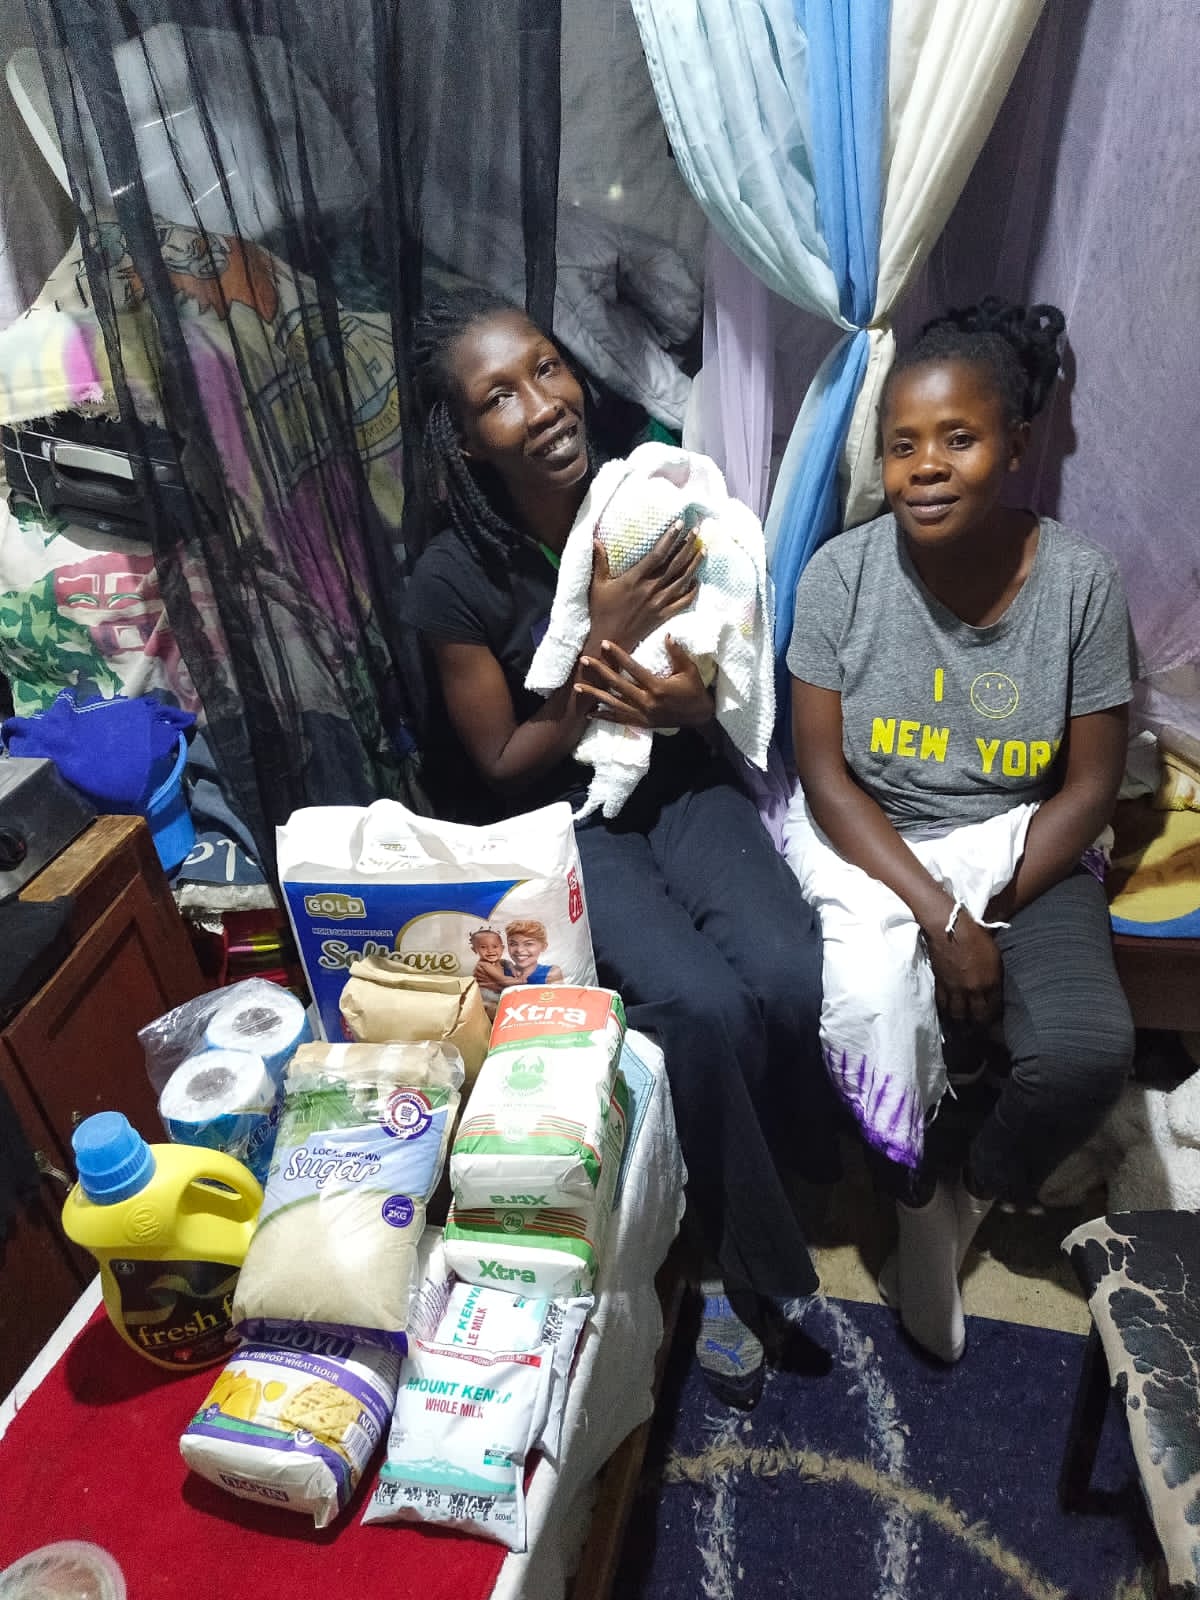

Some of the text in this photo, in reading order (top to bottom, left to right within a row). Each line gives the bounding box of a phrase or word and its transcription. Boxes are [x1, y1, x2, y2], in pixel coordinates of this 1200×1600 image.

[934, 668, 944, 702] I
[870, 718, 1060, 777] NEW YOR
[308, 899, 361, 913] GOLD
[500, 1003, 588, 1026] Xtra
[312, 1147, 343, 1158] LOC
[283, 1147, 382, 1190] Sugar
[387, 1209, 408, 1221] 2KG
[477, 1259, 537, 1284] Xtra
[457, 1286, 484, 1331] KENYA
[471, 1307, 488, 1330] MILK
[138, 1311, 217, 1347] fresh
[285, 1358, 312, 1371] WHEAT
[313, 1366, 340, 1382] FLOUR
[406, 1376, 460, 1396] MOUNT
[425, 1397, 458, 1415] WHOLE
